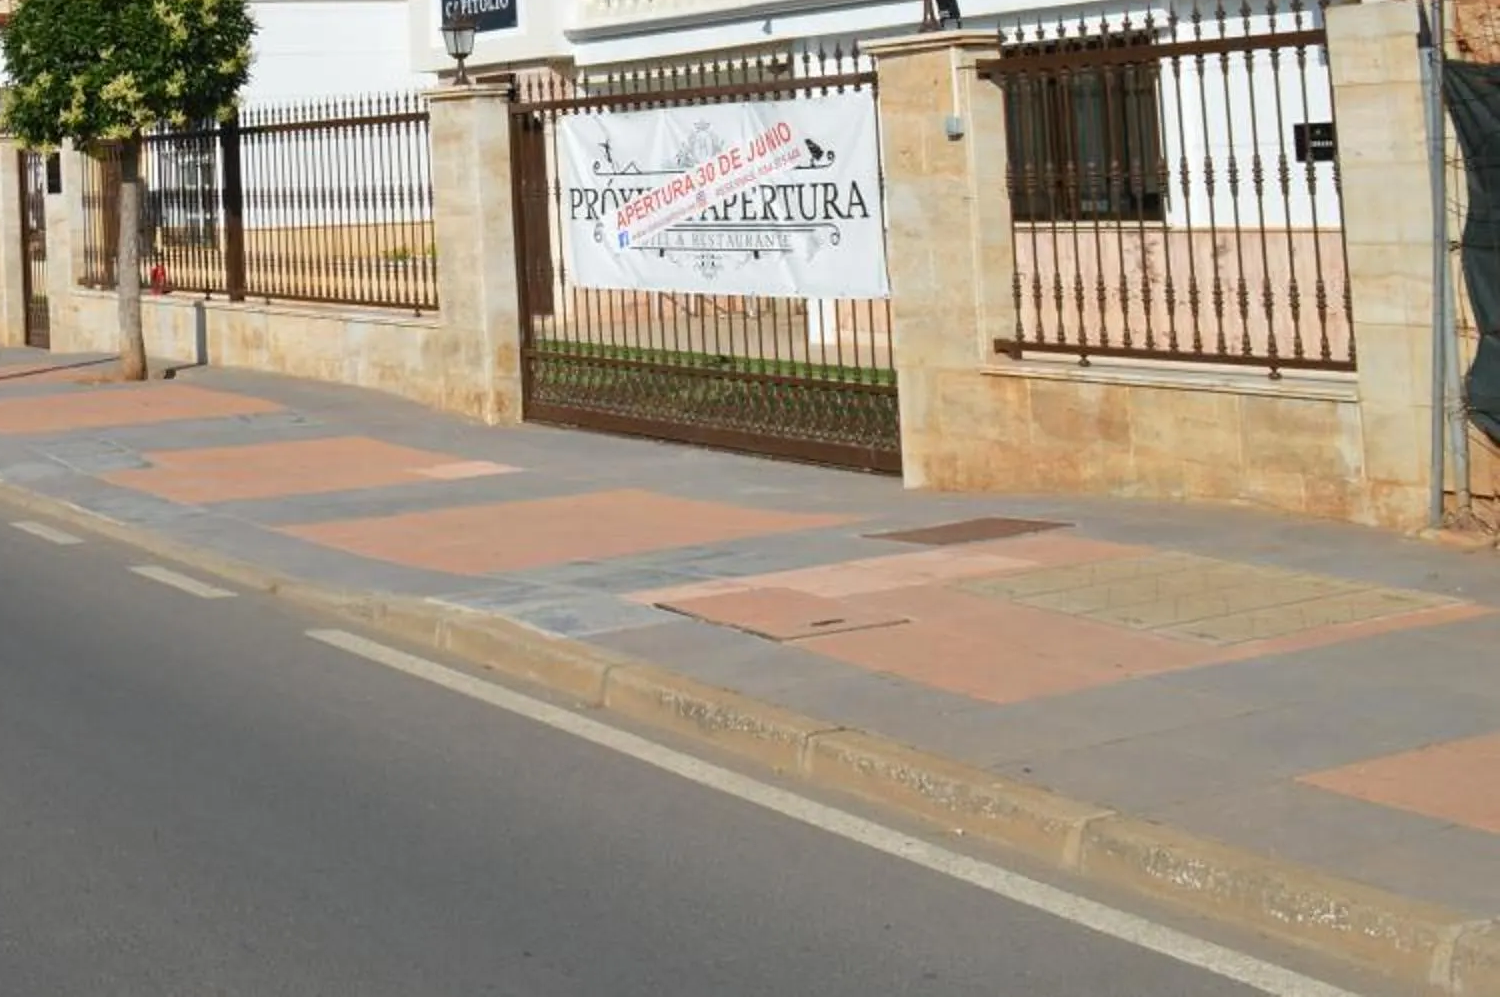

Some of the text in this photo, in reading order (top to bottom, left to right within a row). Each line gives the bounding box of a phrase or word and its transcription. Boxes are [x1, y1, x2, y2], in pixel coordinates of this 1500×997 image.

[617, 175, 694, 229] APERTURA
[697, 162, 715, 187] 30
[718, 147, 743, 176] DE
[746, 122, 792, 163] JUNIO
